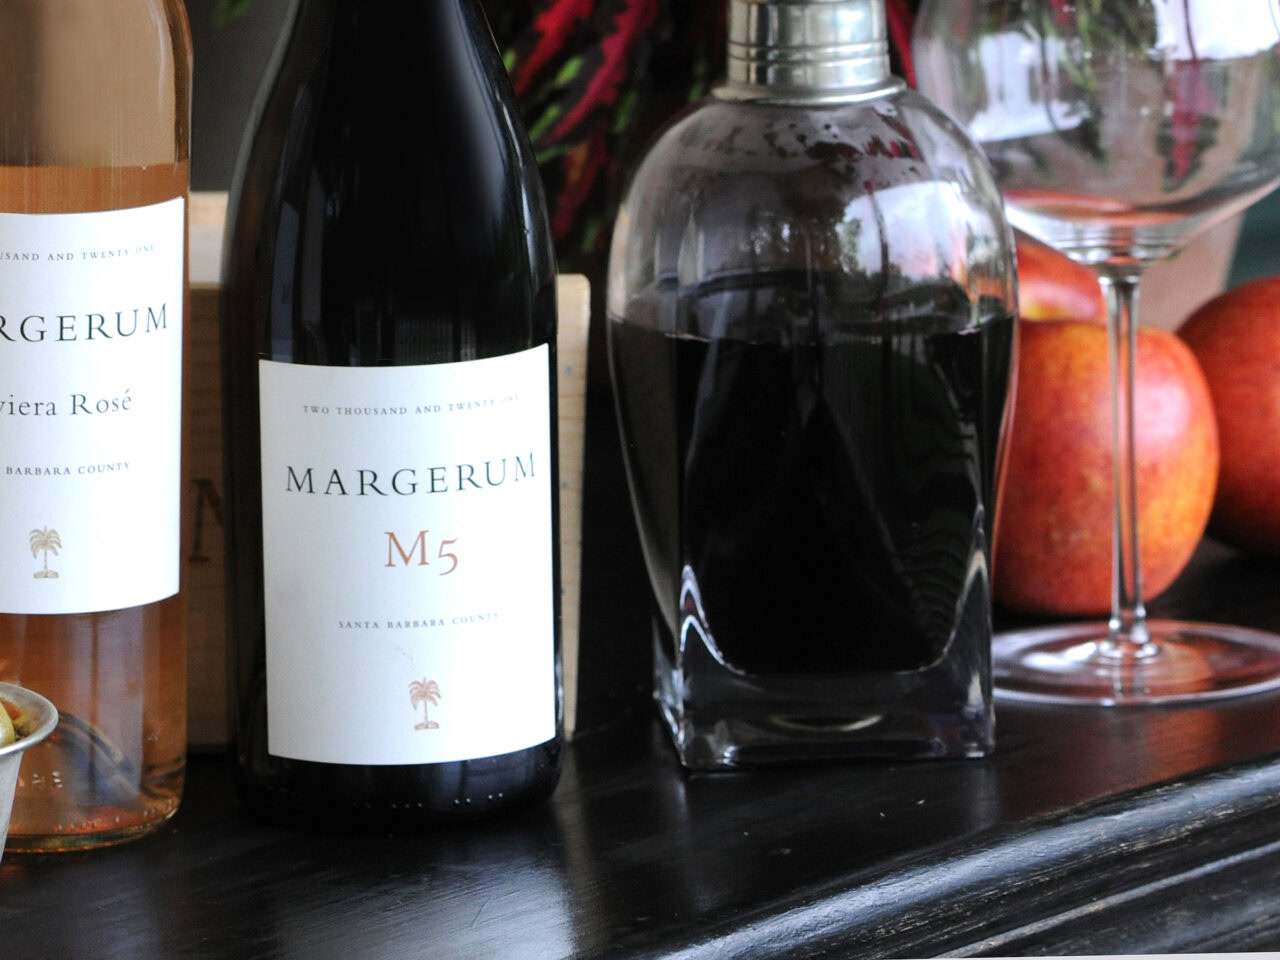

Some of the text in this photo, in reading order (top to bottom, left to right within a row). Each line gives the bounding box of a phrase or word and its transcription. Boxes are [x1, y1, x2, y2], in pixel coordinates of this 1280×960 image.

[47, 252, 75, 262] AND
[80, 247, 129, 261] TWENTY
[69, 387, 133, 416] Rosé
[302, 404, 330, 415] TWO
[335, 406, 408, 416] THOUSAND
[414, 404, 442, 415] AND
[447, 398, 495, 413] TWENTY
[5, 465, 71, 476] BARBARA
[77, 460, 131, 476] COUNTY
[285, 451, 535, 497] MARGERUM
[383, 529, 459, 577] M5
[338, 611, 499, 630] SANTA BARBARA COUNTY
